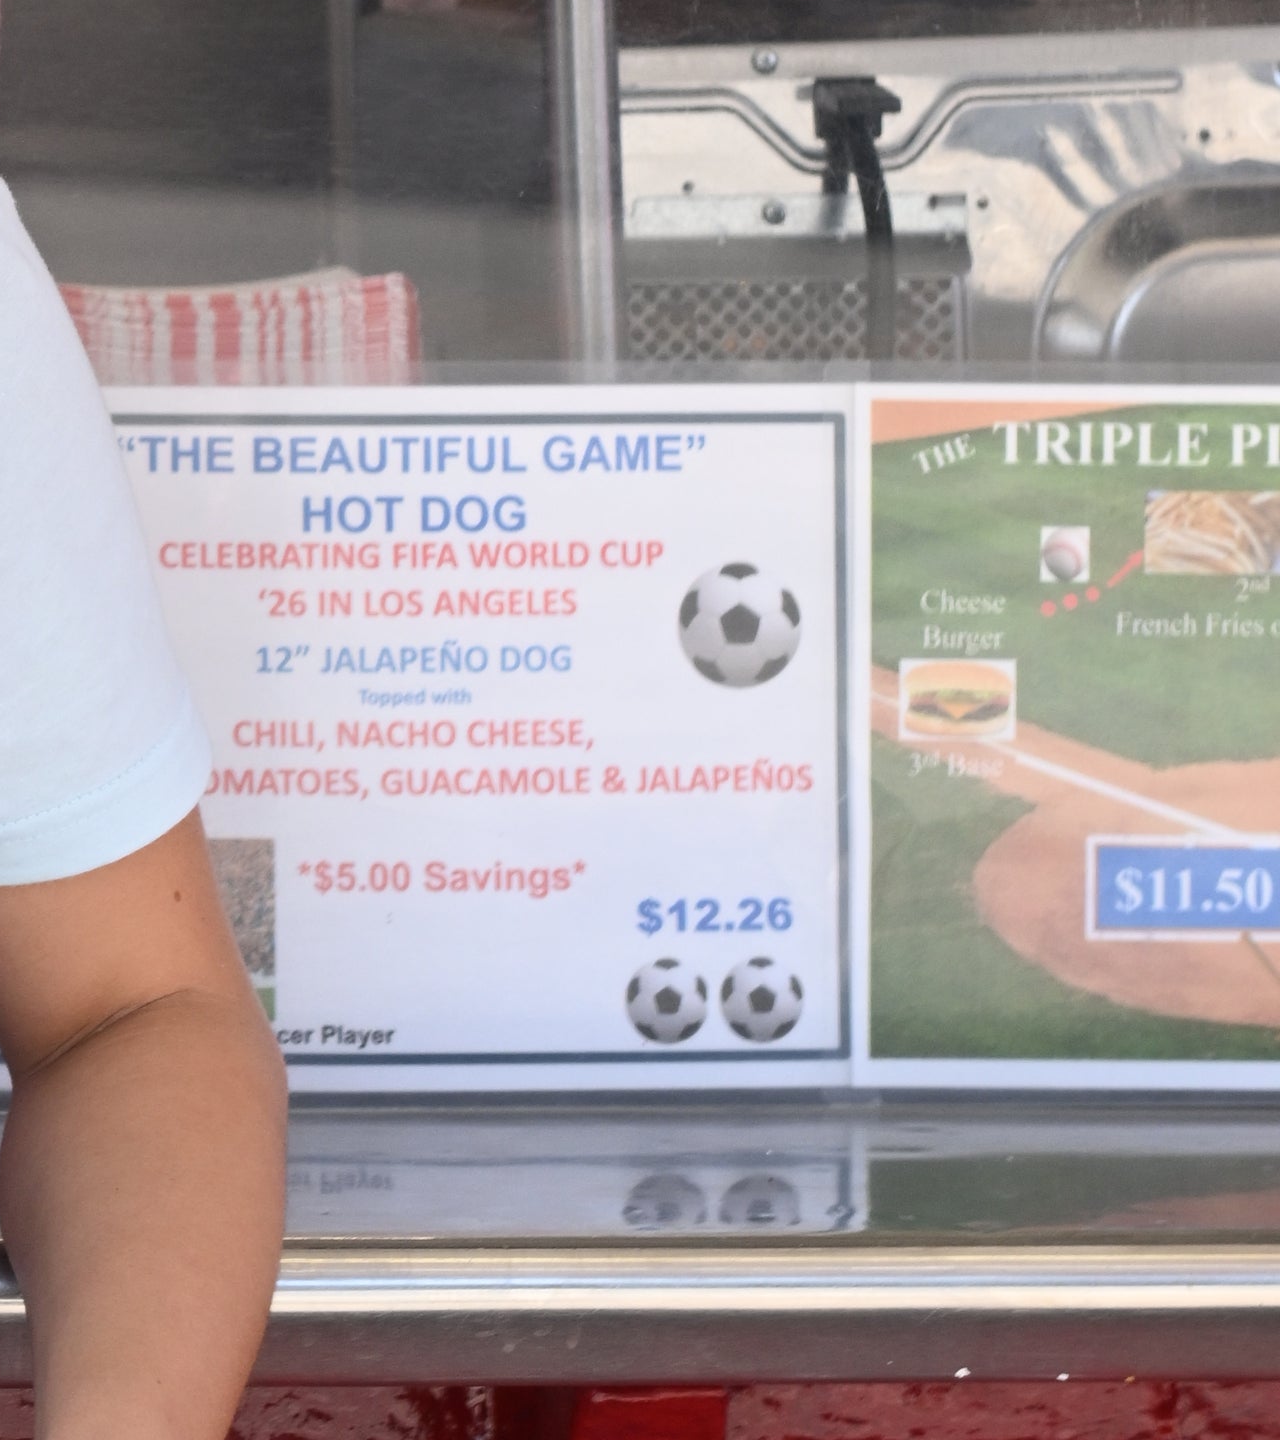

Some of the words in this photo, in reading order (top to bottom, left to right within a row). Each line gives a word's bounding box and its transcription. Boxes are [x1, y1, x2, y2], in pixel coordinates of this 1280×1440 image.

[251, 435, 528, 475] BEAUTIFUL
[542, 434, 707, 473] GAME”
[913, 431, 977, 476] THE
[993, 422, 1210, 467] TRIPLE
[301, 495, 406, 535] HOT
[420, 494, 528, 534] DOG
[156, 540, 382, 570] CELEBRATING
[392, 541, 460, 569] FIFA
[468, 541, 592, 569] WORLD
[599, 540, 665, 568] CUP
[317, 589, 354, 618] IN
[363, 589, 425, 618] LOS
[432, 588, 579, 617] ANGELES
[920, 588, 1007, 616] Cheese
[922, 624, 1005, 655] Burger
[1115, 610, 1198, 637] French
[1205, 610, 1265, 638] Fries
[319, 639, 490, 675] JALAPEÑO
[499, 644, 573, 673] DOG
[357, 687, 429, 709] Topped
[430, 687, 474, 705] with
[229, 717, 327, 754] CHILI,
[335, 720, 458, 749] NACHO
[466, 719, 595, 751] CHEESE,
[205, 766, 371, 800] OMATOES,
[379, 766, 591, 797] GUACAMOLE
[601, 765, 627, 794] &
[1114, 867, 1273, 914] $11.50
[636, 896, 795, 937] $12.26
[275, 1028, 315, 1047] cer
[320, 1024, 396, 1050] Player
